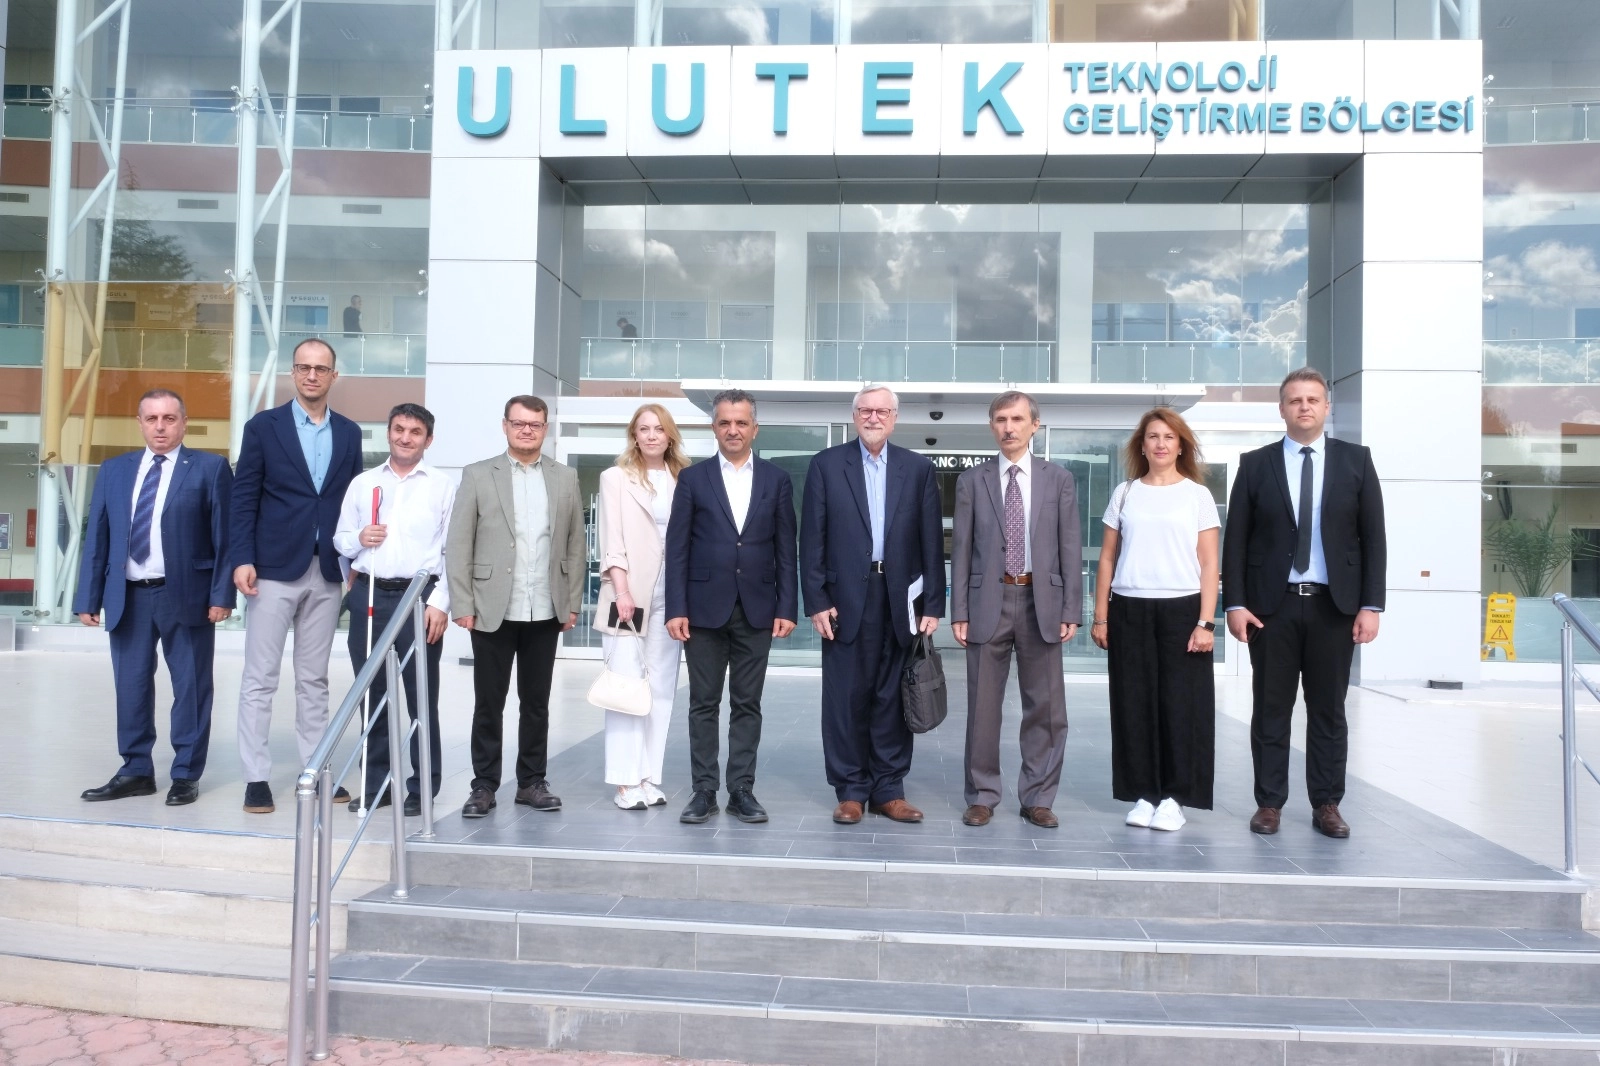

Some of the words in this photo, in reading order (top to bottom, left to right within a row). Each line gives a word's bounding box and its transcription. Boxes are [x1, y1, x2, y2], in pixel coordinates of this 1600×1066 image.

[1064, 56, 1278, 93] TEKNOLOJİ
[456, 61, 1025, 138] ULUTEK
[1063, 98, 1292, 142] GELİŞTİRME
[1301, 96, 1475, 133] BÖLGESİ
